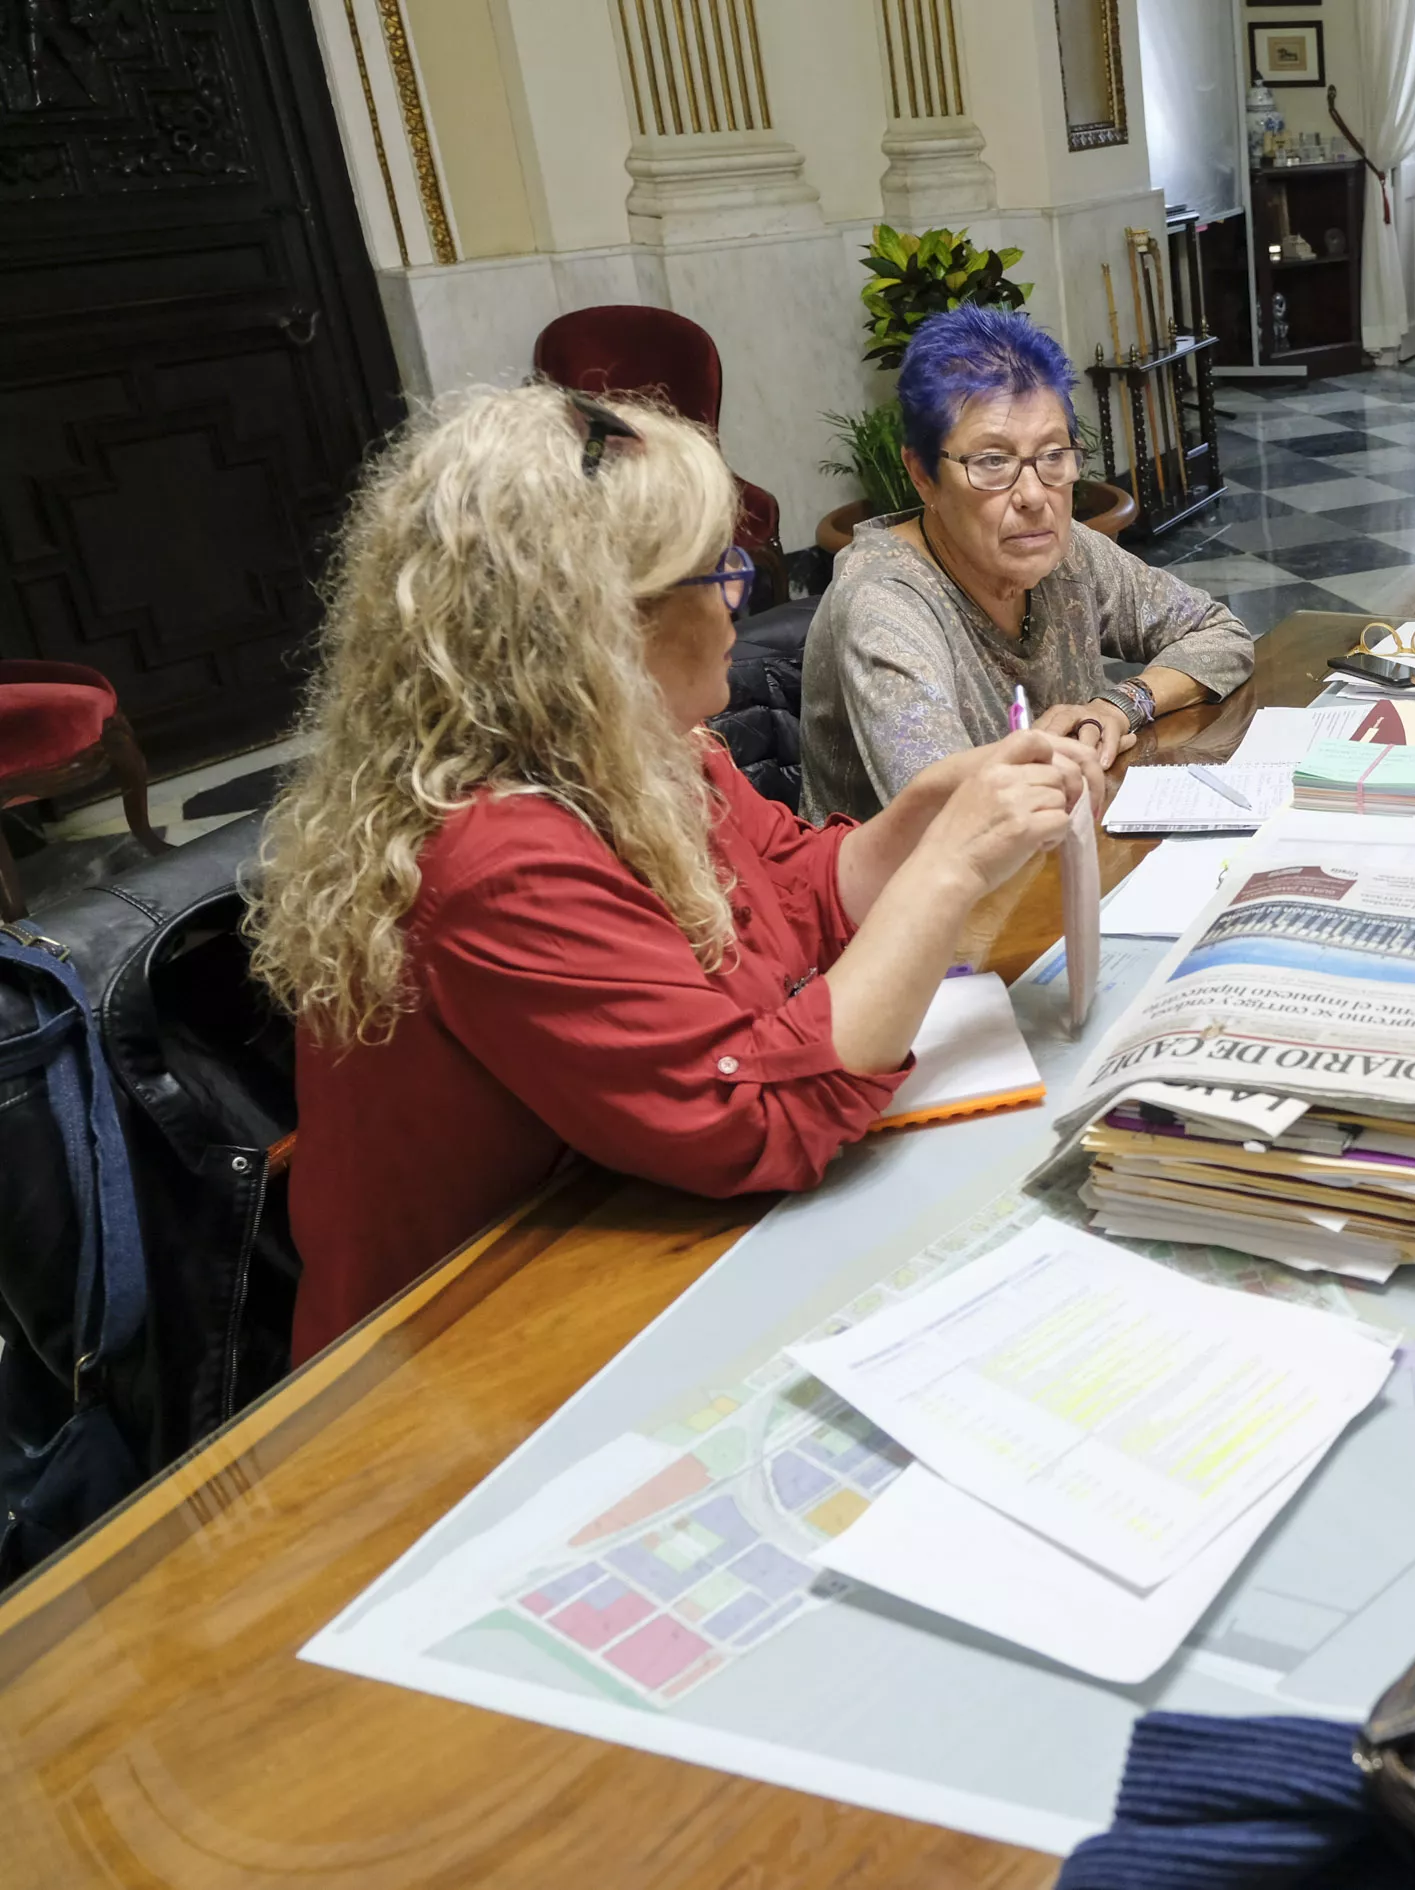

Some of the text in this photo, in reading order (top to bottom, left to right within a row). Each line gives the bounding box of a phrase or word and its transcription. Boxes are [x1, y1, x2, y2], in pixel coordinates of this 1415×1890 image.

[1341, 914, 1360, 922] su
[1362, 917, 1408, 930] llevan
[1219, 996, 1233, 1006] y
[1251, 987, 1349, 1008] impuesto
[1150, 997, 1215, 1019] endosa
[1231, 997, 1308, 1015] corrige
[1351, 1000, 1372, 1011] el
[1311, 1006, 1334, 1019] se
[1207, 1039, 1276, 1066] DE
